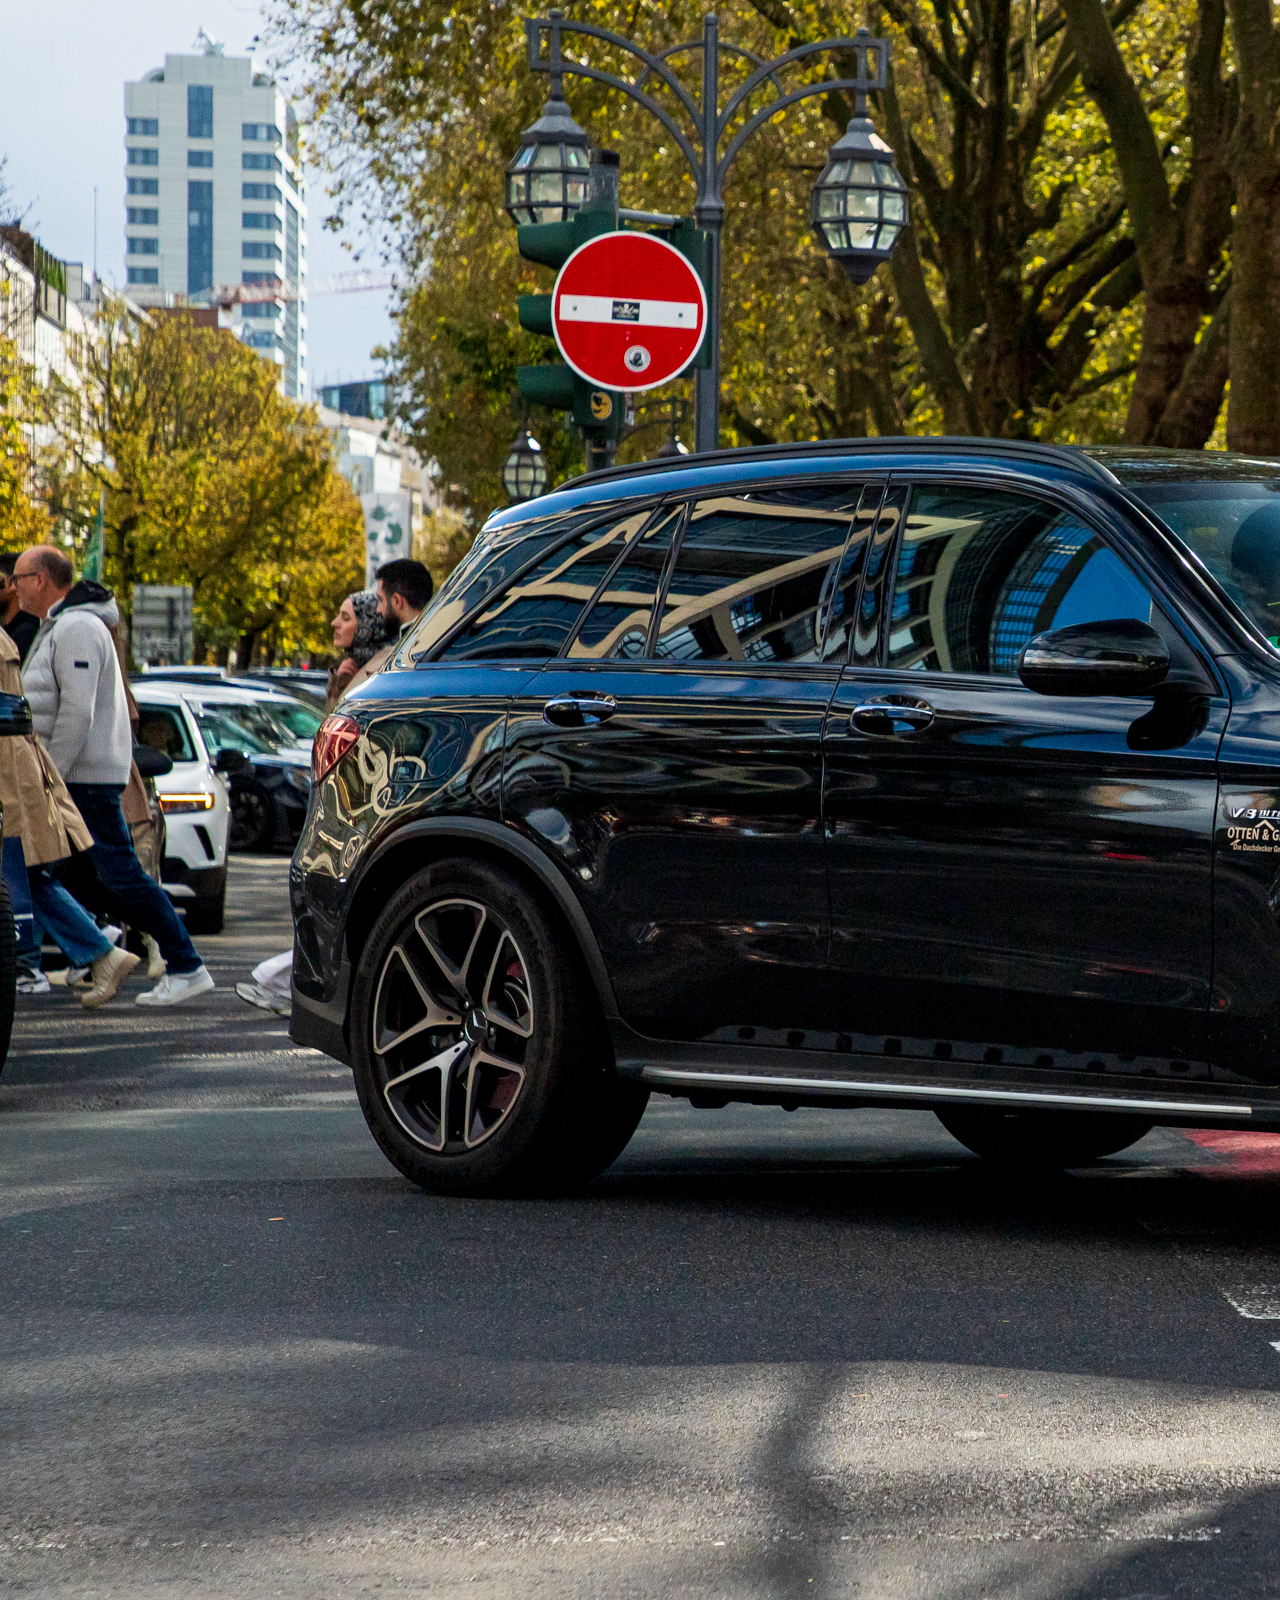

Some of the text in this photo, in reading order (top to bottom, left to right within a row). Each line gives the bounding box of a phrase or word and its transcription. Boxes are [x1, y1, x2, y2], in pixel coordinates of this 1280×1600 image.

[1231, 807, 1258, 819] V8
[1227, 826, 1260, 840] OTTEN
[1261, 828, 1270, 841] &
[1232, 843, 1242, 851] Die
[1242, 843, 1273, 853] Dachdecker
